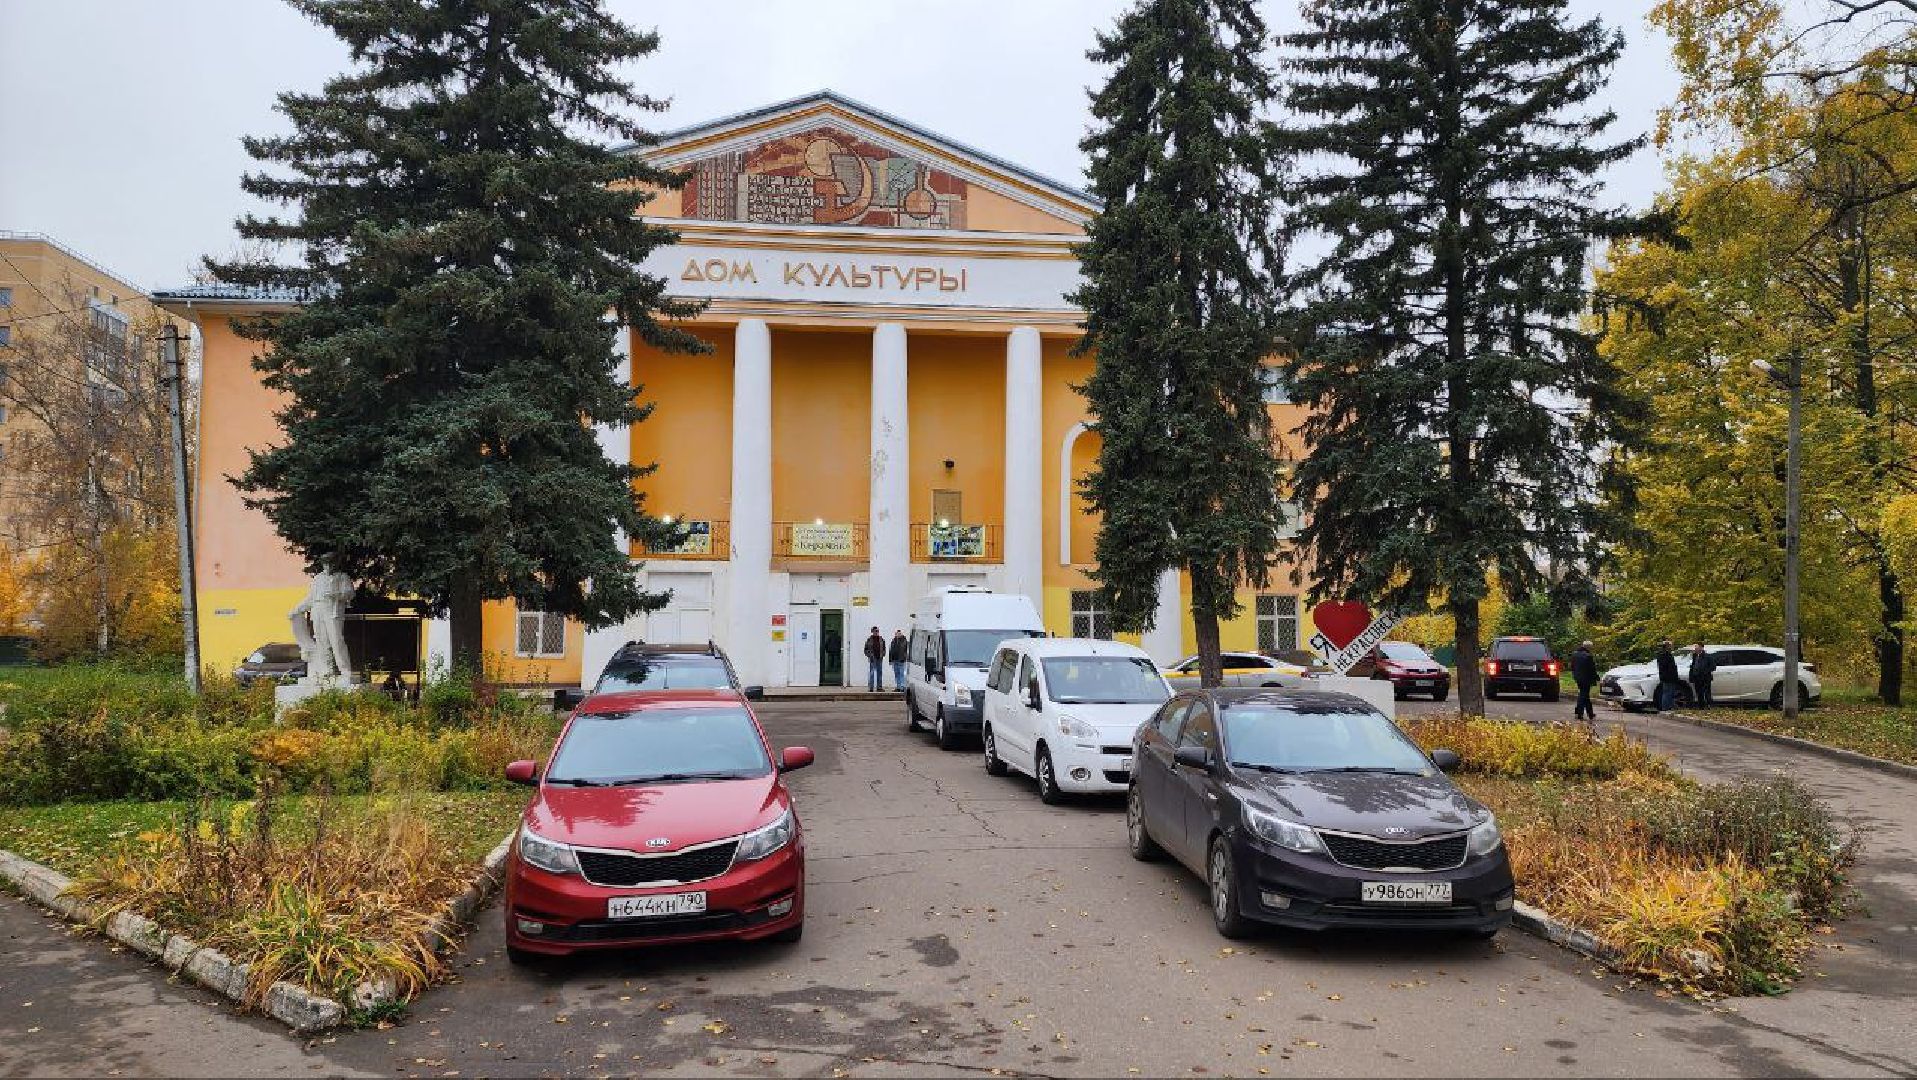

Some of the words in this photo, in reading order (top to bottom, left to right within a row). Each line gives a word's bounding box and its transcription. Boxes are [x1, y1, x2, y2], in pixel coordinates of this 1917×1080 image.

[681, 258, 756, 283] ДОМ
[784, 262, 966, 292] КУЛЬТУРЫ
[1310, 633, 1337, 660] Я
[1334, 611, 1399, 671] НЕКРАСОВСК
[679, 893, 704, 907] 790
